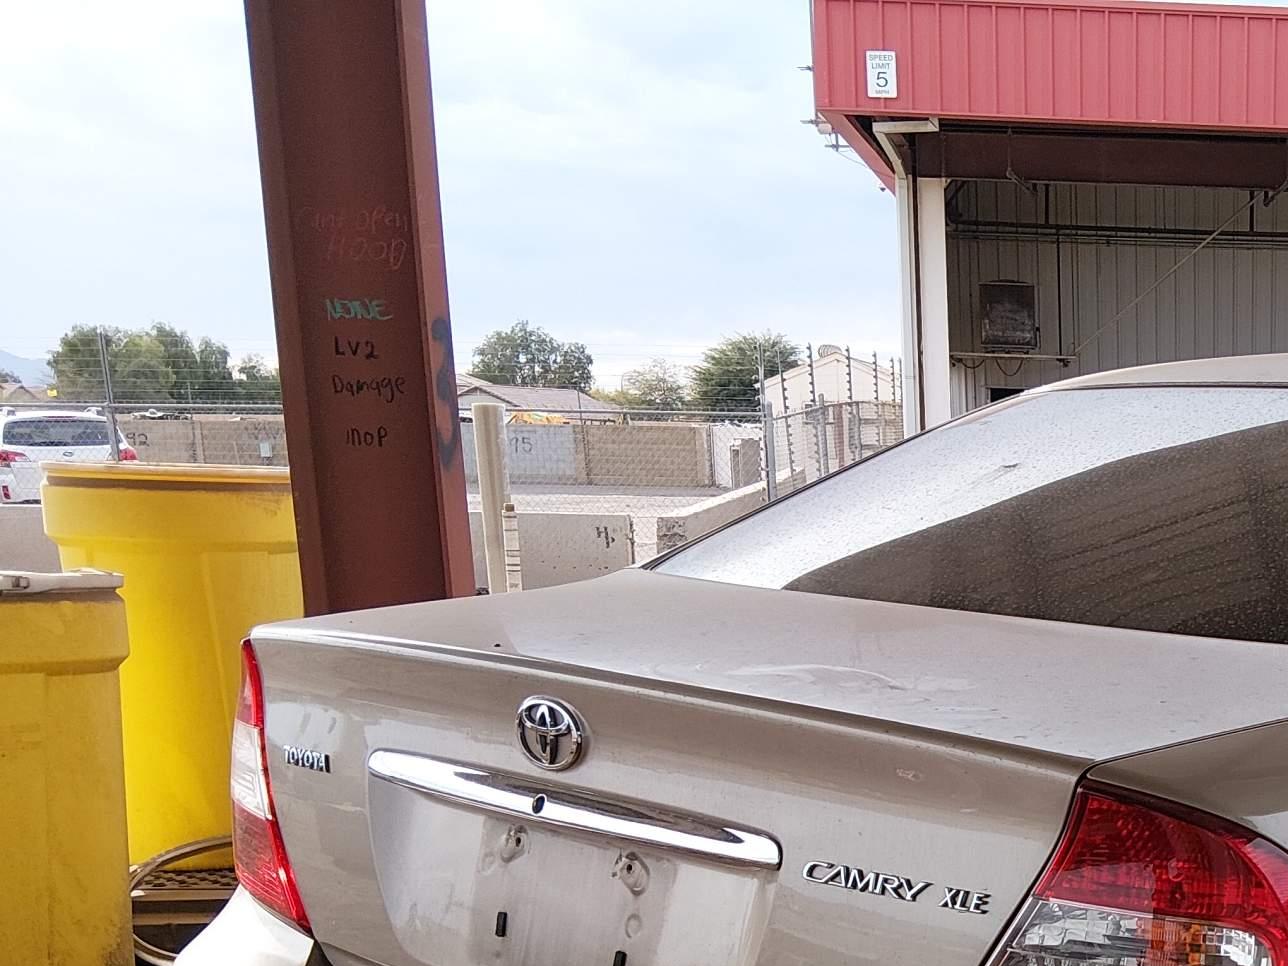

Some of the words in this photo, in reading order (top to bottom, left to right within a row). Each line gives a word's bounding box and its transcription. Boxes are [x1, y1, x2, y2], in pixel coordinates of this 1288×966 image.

[872, 62, 890, 70] LIMIT
[876, 71, 888, 88] 5
[331, 374, 406, 403] Damage
[283, 745, 331, 773] TOYOTA
[801, 860, 934, 902] CAMRY
[937, 887, 992, 914] XLE
